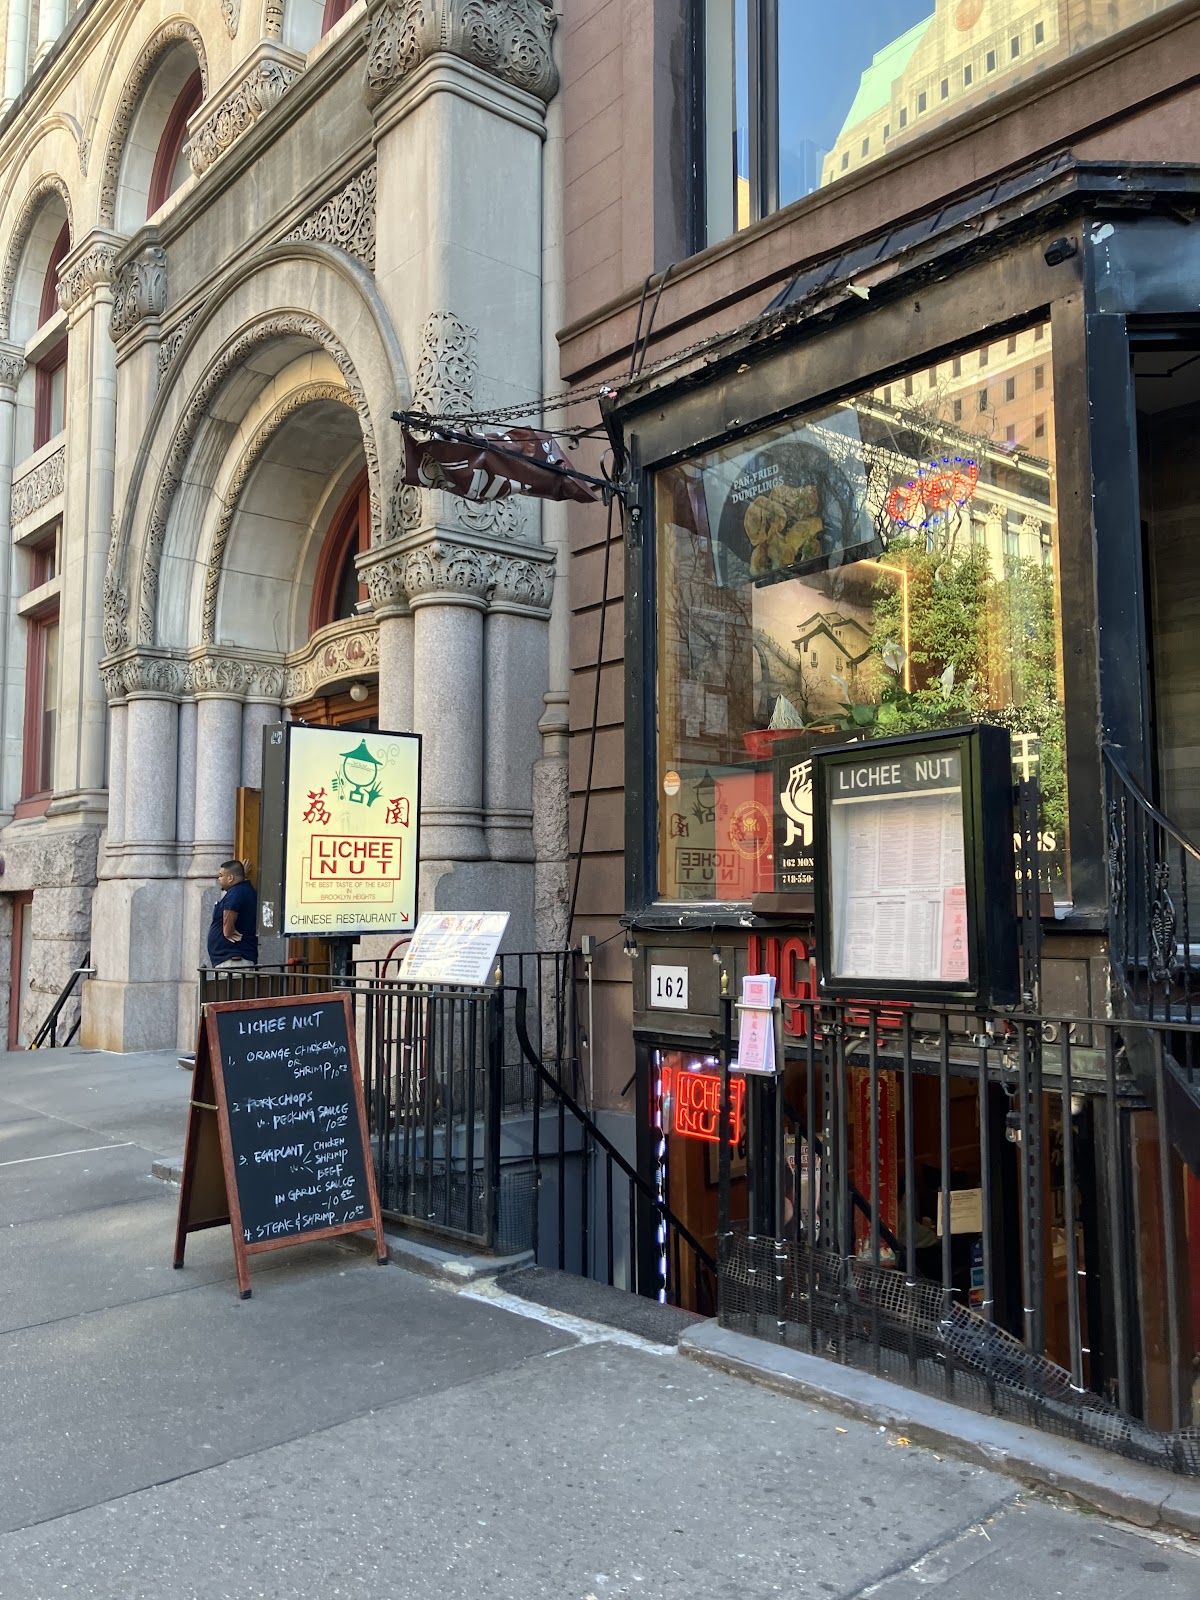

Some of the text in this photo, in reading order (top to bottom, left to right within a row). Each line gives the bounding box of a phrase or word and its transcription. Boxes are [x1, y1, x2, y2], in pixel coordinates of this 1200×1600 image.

[734, 464, 778, 490] PAN-FRIED
[732, 476, 784, 504] DUMPLINGS
[888, 465, 977, 518] OPEN
[840, 758, 953, 790] LICHEE NUT
[319, 840, 393, 858] LICHEE
[320, 860, 392, 874] NUT
[782, 858, 796, 867] 162
[290, 913, 397, 925] CHINESE RESTAURANT
[657, 976, 683, 998] 162
[240, 1011, 323, 1034] LICHEE NUT
[247, 1048, 290, 1061] ORANGE
[287, 1058, 302, 1068] OR
[294, 1062, 331, 1079] SHRIMP
[680, 1076, 738, 1113] LICHE
[317, 1103, 349, 1117] SAUCE
[313, 1137, 344, 1151] CHICKEN
[315, 1149, 349, 1165] SHRIMP
[317, 1164, 343, 1180] BEEF
[275, 1176, 355, 1206] IN GARLIC SAUCE
[256, 1219, 294, 1237] STEAK
